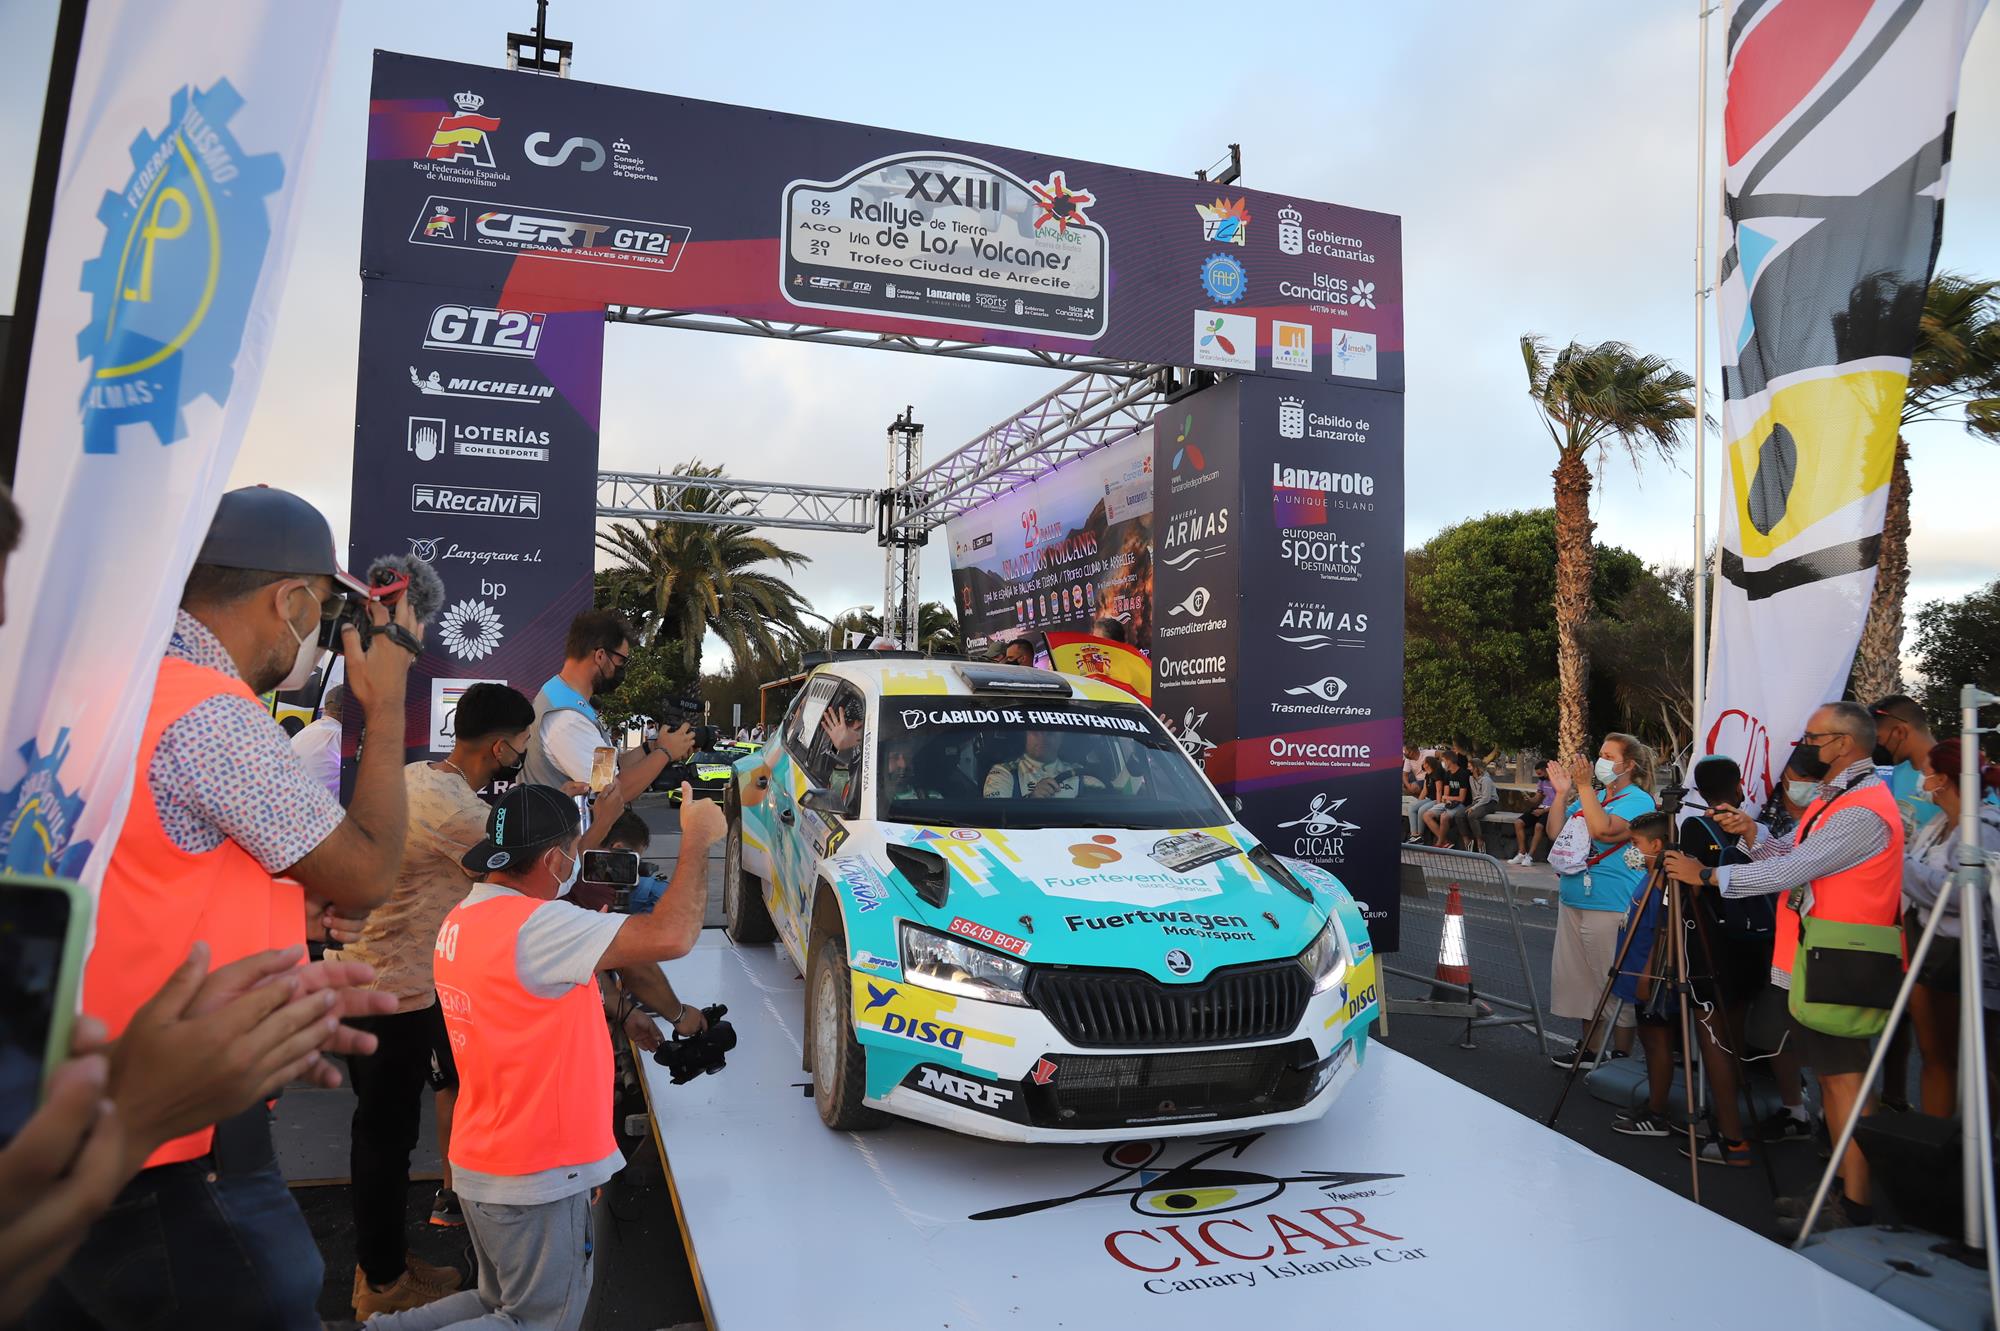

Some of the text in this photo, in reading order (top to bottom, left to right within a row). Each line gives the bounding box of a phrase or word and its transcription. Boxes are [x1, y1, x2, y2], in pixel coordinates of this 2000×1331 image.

[614, 155, 644, 166] Consejo
[614, 162, 646, 173] Superior
[413, 161, 511, 182] Real Federación Española
[426, 172, 498, 188] de Automovilismo
[624, 171, 658, 182] Deportes
[905, 168, 1000, 211] XXIII
[811, 200, 831, 209] 06
[811, 208, 832, 216] 07
[850, 197, 988, 236] Rallye de Tierra
[475, 211, 672, 252] CERT GT2i
[800, 222, 842, 234] AGO
[1035, 227, 1082, 244] LANZAROTE
[810, 240, 830, 249] 20
[1307, 229, 1362, 248] Gobierno
[478, 238, 504, 246] COPA
[521, 242, 559, 252] ESPAÑA
[575, 249, 616, 259] RALLYES
[632, 256, 665, 264] TIERRA
[810, 248, 828, 256] 21
[850, 232, 870, 246] Isla
[876, 228, 909, 250] de
[921, 230, 958, 256] Los
[970, 238, 1071, 270] Volcanes
[1308, 242, 1376, 264] de Canarias
[850, 250, 1071, 290] Trofeo Ciudad de Arrecife
[809, 276, 852, 288] CERT
[1313, 272, 1348, 292] Islas
[926, 288, 971, 302] Lanzarote
[976, 296, 1008, 308] sports
[1279, 281, 1349, 305] Canarias
[1030, 310, 1049, 318] Canarias
[1056, 309, 1084, 318] Canarias
[1068, 305, 1084, 313] Islas
[430, 306, 545, 350] GT2i
[448, 378, 555, 398] MICHELIN
[1308, 413, 1370, 431] Cabildo de
[454, 424, 550, 446] LOTERÍAS
[1308, 426, 1366, 443] Lanzarote
[464, 446, 484, 454] CON
[499, 449, 539, 458] DEPORTE
[1273, 462, 1374, 496] Lanzarote
[436, 490, 518, 514] Recalvi
[1273, 494, 1374, 512] A UNIQUE ISLAND
[1171, 508, 1197, 523] NAVIERA
[1021, 508, 1040, 548] 23
[1164, 508, 1228, 550] ARMAS
[1282, 528, 1337, 542] european
[442, 544, 542, 566] Lanzagrava s.l.
[1046, 530, 1098, 567] VOLCANES
[1281, 540, 1362, 566] sports
[1301, 562, 1357, 574] DESTINATION
[481, 578, 506, 600] bp
[1288, 602, 1326, 610] NAVIERA
[1160, 618, 1227, 638] Trasmediterránea
[1280, 609, 1368, 632] ARMAS
[1160, 655, 1226, 678] Orvecame
[1270, 703, 1372, 716] Trasmediterránea
[929, 710, 1151, 734] CABILDO DE FUERTEVENTURA
[1270, 738, 1370, 759] Orvecame
[496, 807, 506, 846] sparco
[1294, 838, 1344, 856] CICAR
[1045, 872, 1208, 889] Fuerteventura
[1164, 882, 1213, 894] Canarias
[1064, 909, 1248, 932] Fuertwagen
[1363, 910, 1388, 919] GRUPO
[435, 920, 460, 962] 40
[951, 919, 960, 932] S
[961, 922, 993, 942] 6419
[994, 934, 1024, 952] BCF
[1162, 924, 1256, 942] Motorsport
[1349, 984, 1377, 1020] DISA
[882, 1012, 964, 1050] DISA
[918, 1066, 1014, 1110] MRF
[1104, 1205, 1404, 1273] CICAR
[1143, 1243, 1430, 1296] Canary Islands Car
